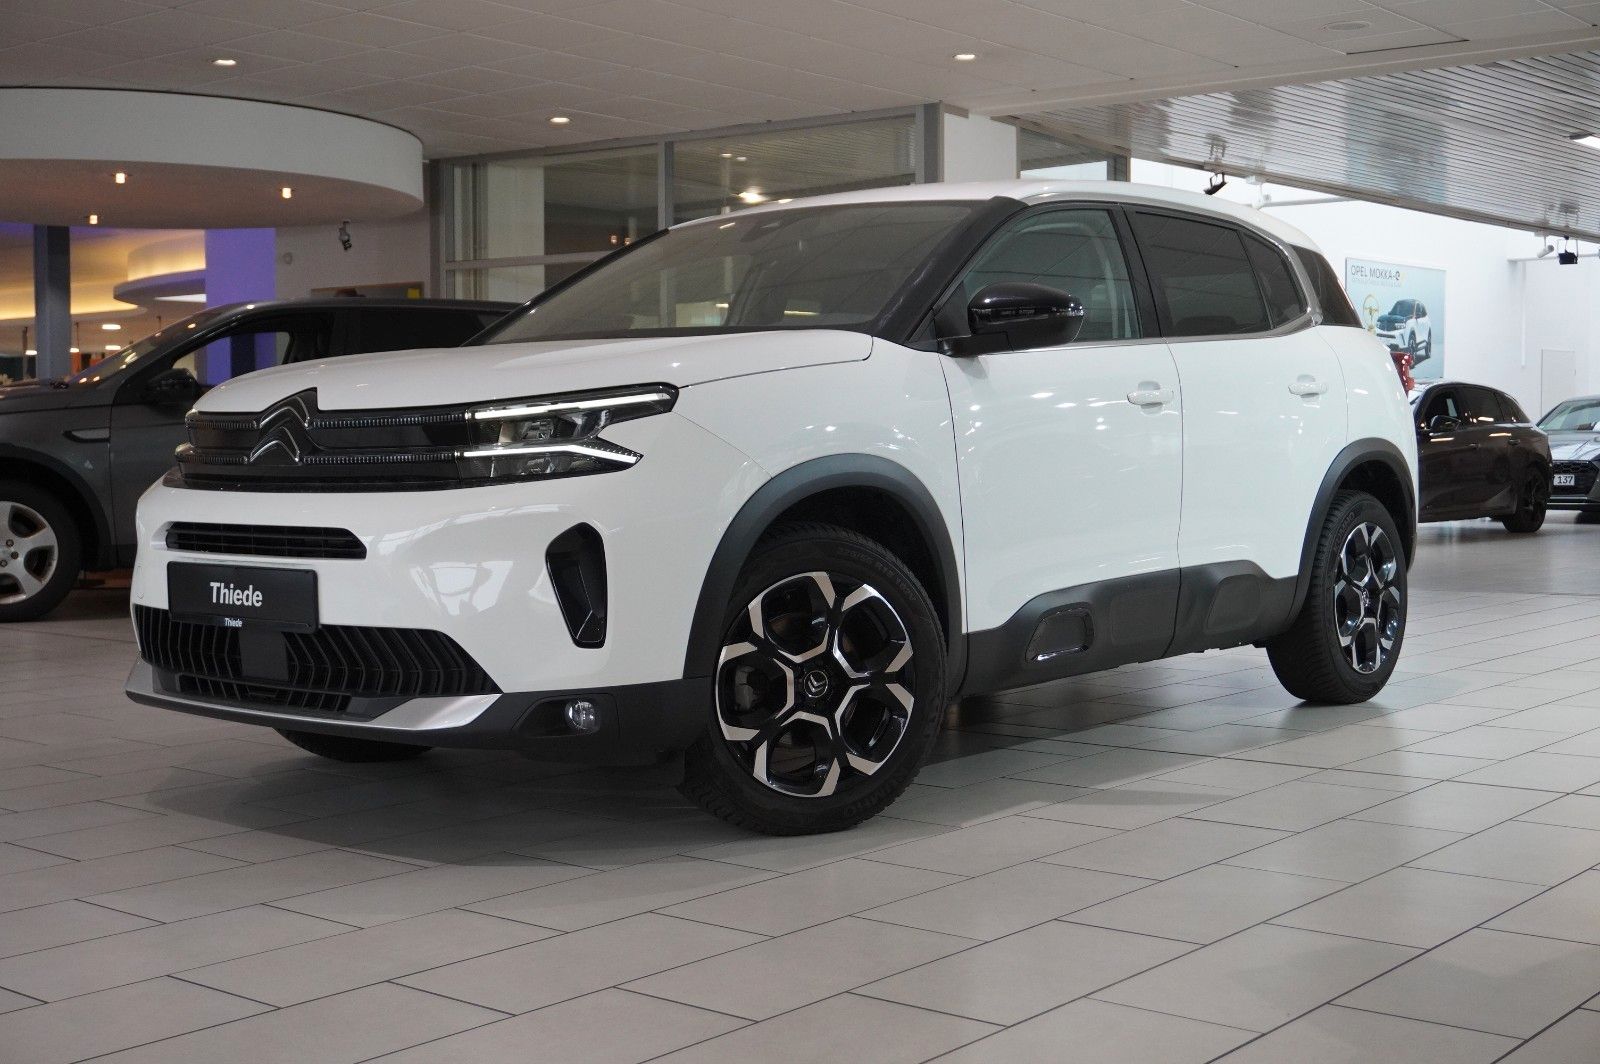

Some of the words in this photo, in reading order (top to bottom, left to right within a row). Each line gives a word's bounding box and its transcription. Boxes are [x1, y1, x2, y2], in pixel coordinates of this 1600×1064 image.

[1351, 265, 1368, 277] OPEL
[1557, 476, 1573, 484] 137
[209, 581, 263, 607] Thiede
[224, 617, 243, 627] Thiede
